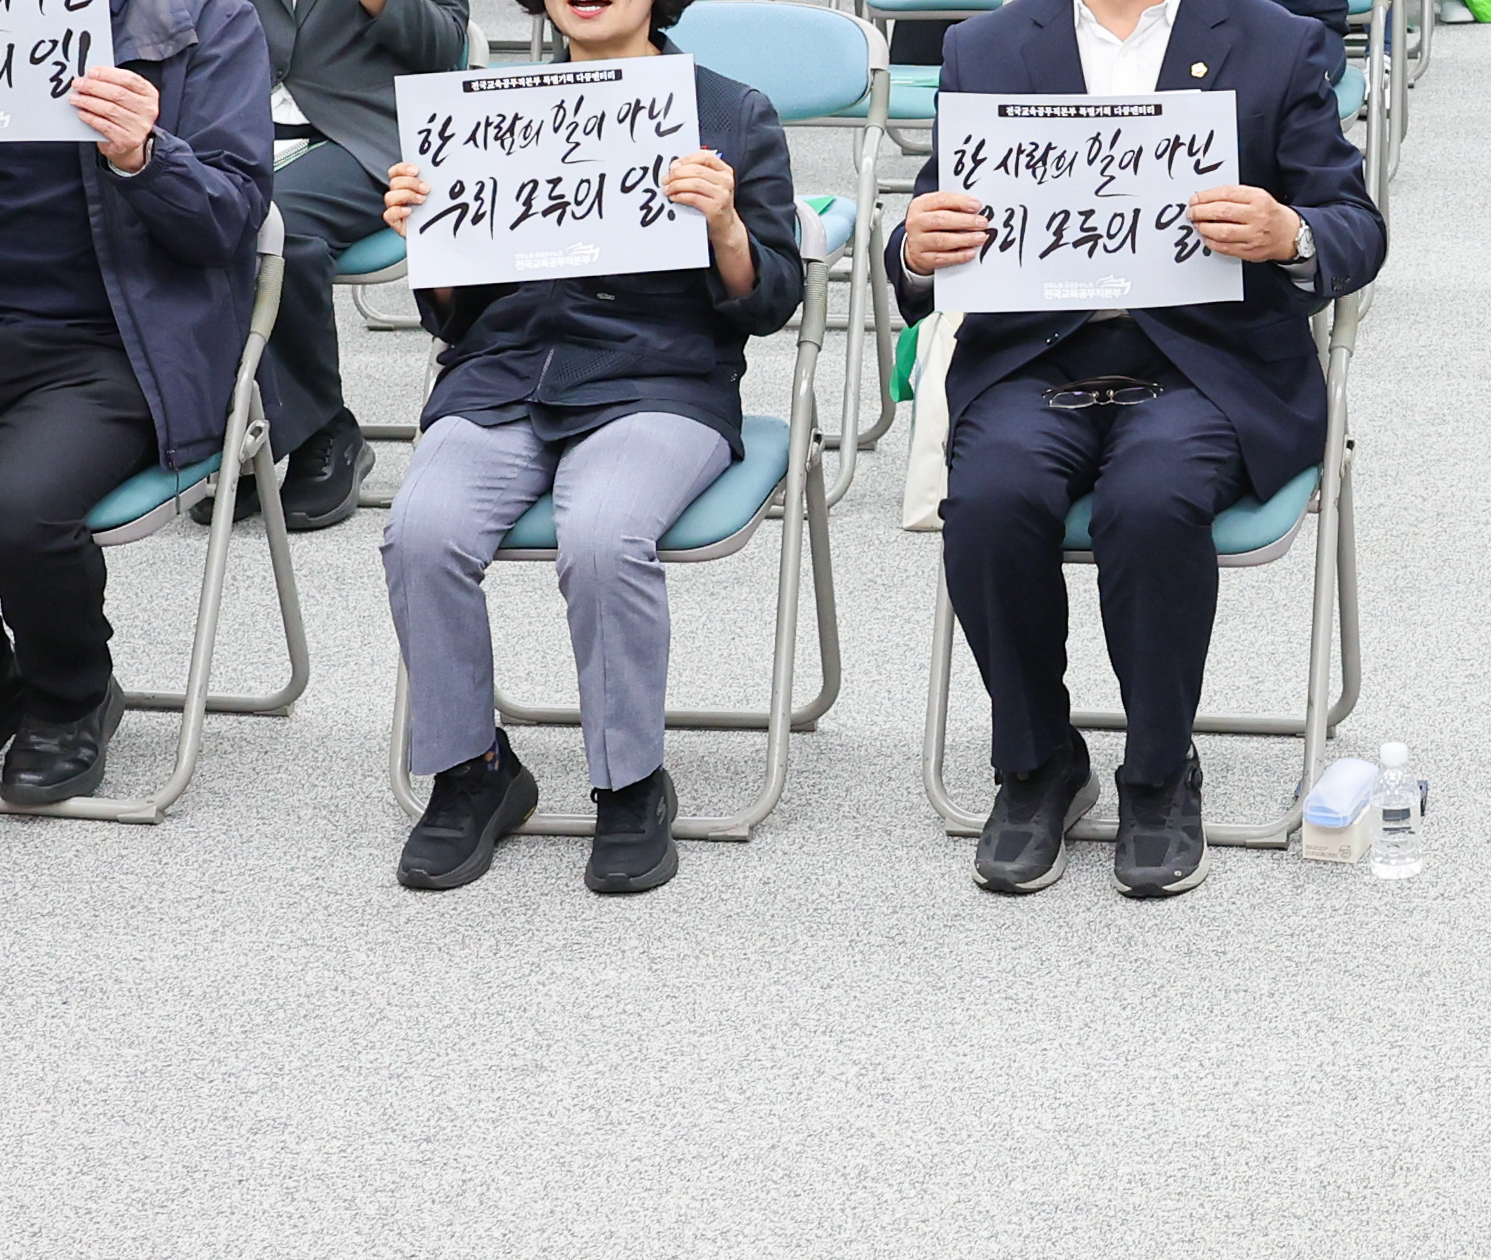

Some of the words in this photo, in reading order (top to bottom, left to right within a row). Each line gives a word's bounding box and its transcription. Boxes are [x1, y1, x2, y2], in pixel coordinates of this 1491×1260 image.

[416, 113, 456, 167] 한
[462, 112, 544, 156] 사람의
[551, 94, 605, 164] 일이
[617, 92, 682, 143] 아닌
[949, 135, 990, 189] 한
[993, 141, 1079, 184] 사람의
[1086, 127, 1143, 197] 일이
[1155, 129, 1223, 179] 아닌
[418, 177, 497, 239] 우리
[509, 173, 606, 230] 모두의
[1038, 208, 1141, 259] 모두의
